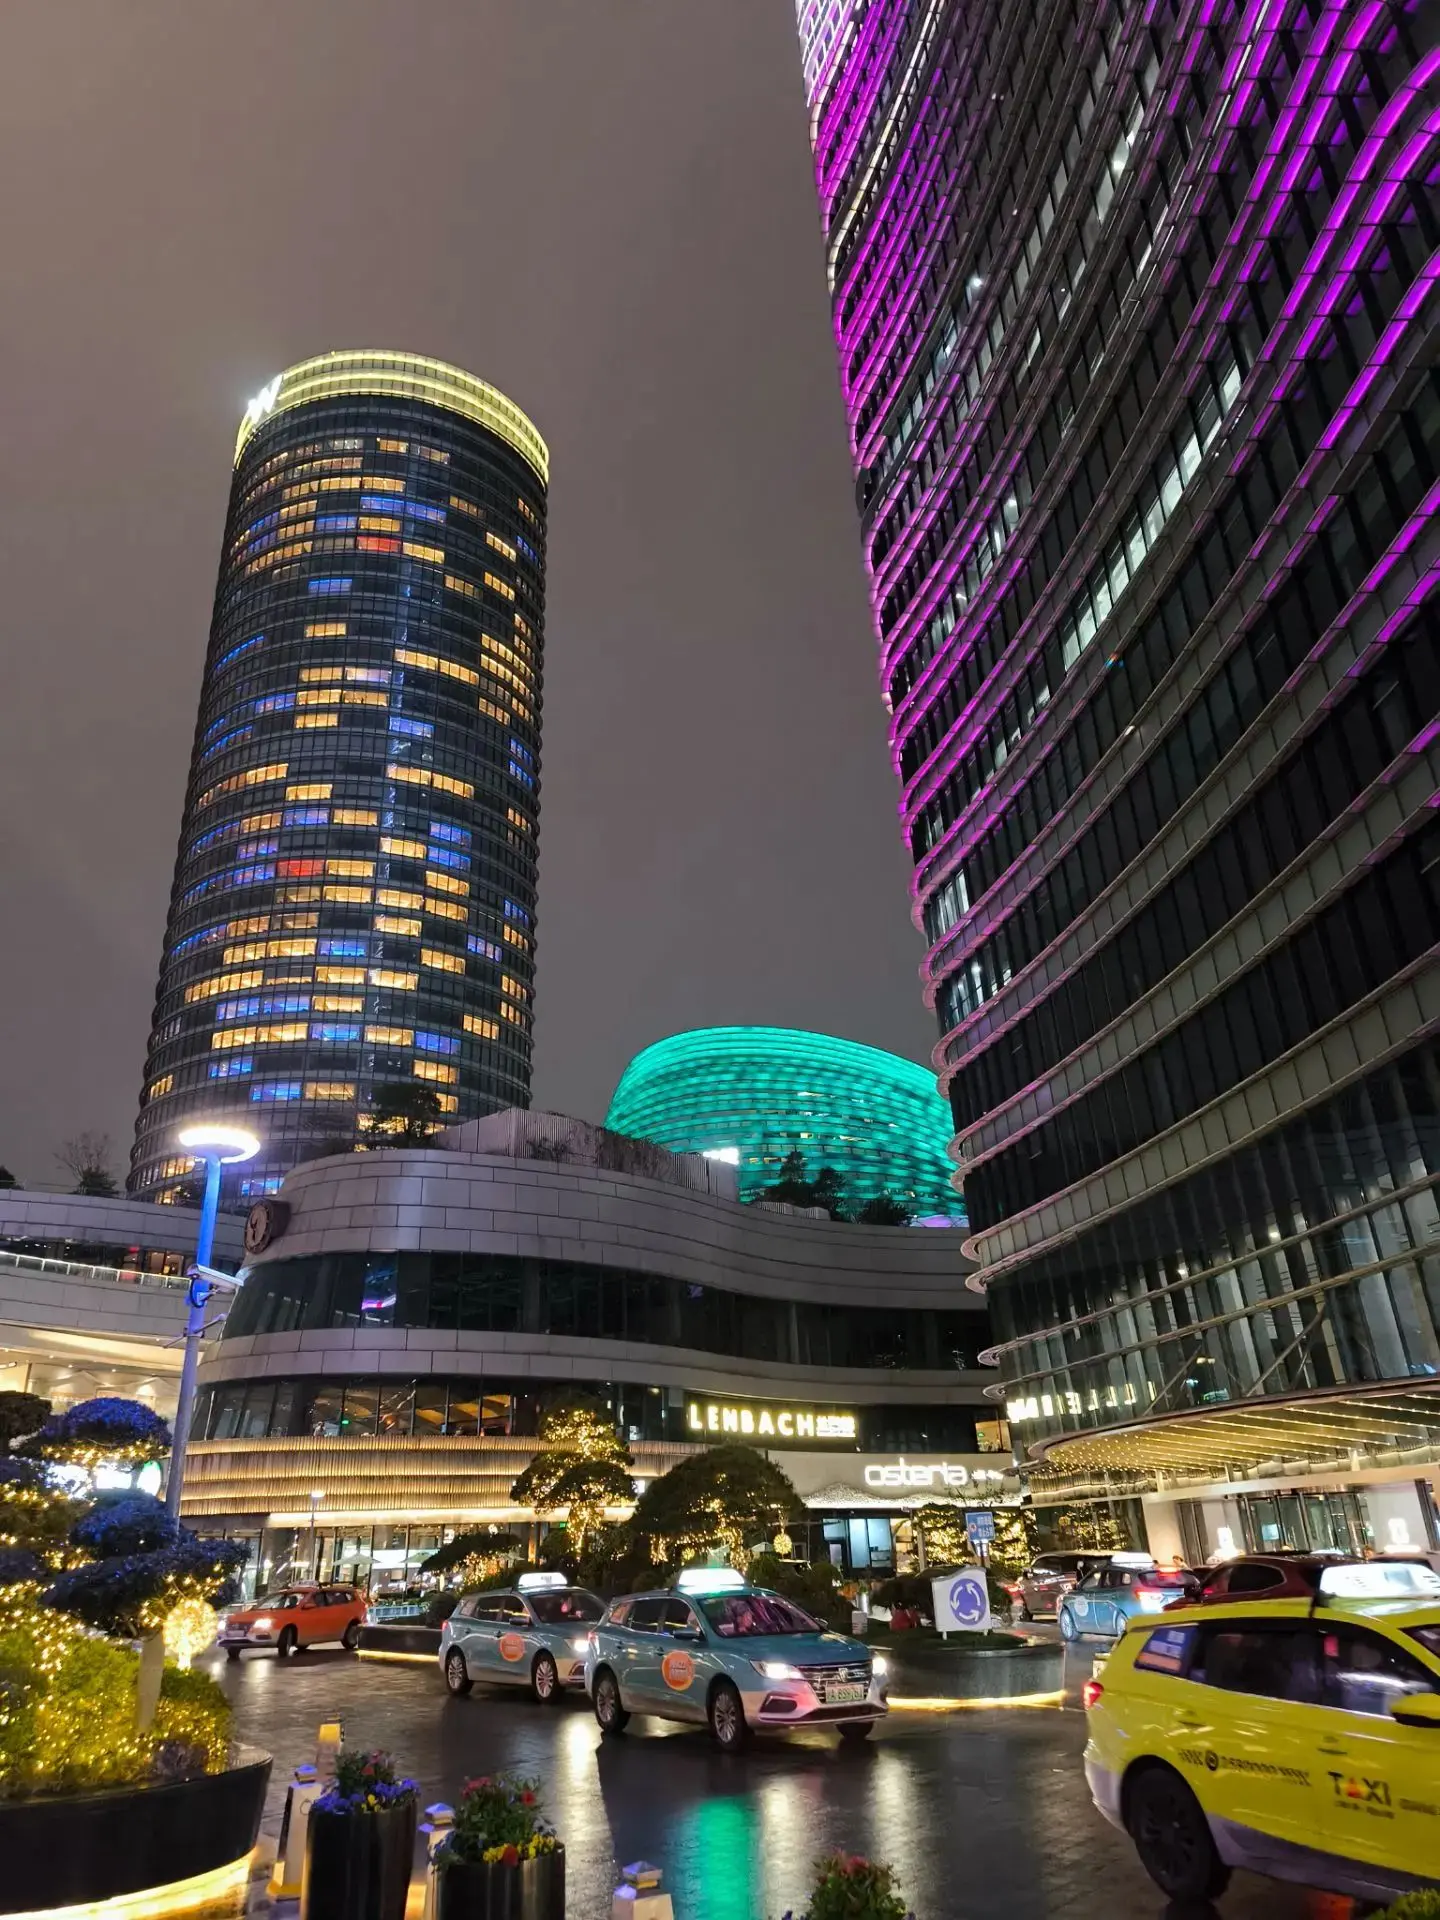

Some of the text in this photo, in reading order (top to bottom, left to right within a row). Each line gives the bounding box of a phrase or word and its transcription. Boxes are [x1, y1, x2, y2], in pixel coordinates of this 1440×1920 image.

[690, 1403, 815, 1437] LENBACH
[864, 1457, 967, 1486] osteria
[1327, 1771, 1392, 1807] TAXI
